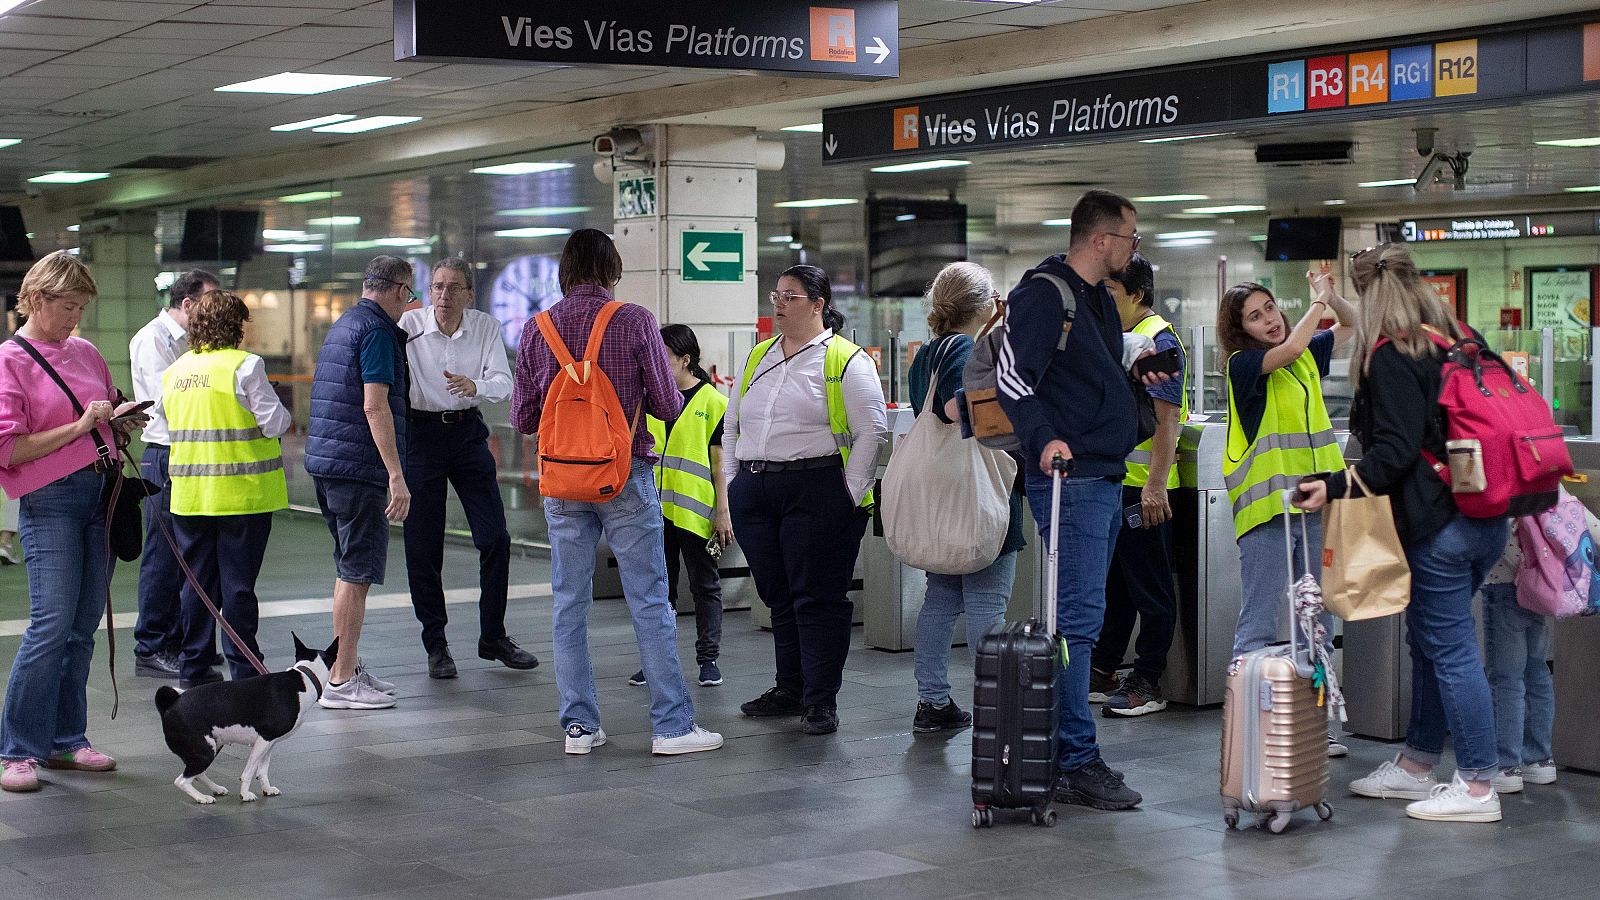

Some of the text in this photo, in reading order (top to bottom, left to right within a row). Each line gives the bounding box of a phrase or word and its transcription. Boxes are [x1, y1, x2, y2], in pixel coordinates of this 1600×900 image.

[501, 16, 804, 59] Vies Vías Platforms
[828, 15, 854, 47] R
[1273, 56, 1475, 100] R1 R3 R4 RG1 R12
[924, 94, 1179, 146] Vies Vías Platforms
[174, 374, 211, 392] logiRAIL
